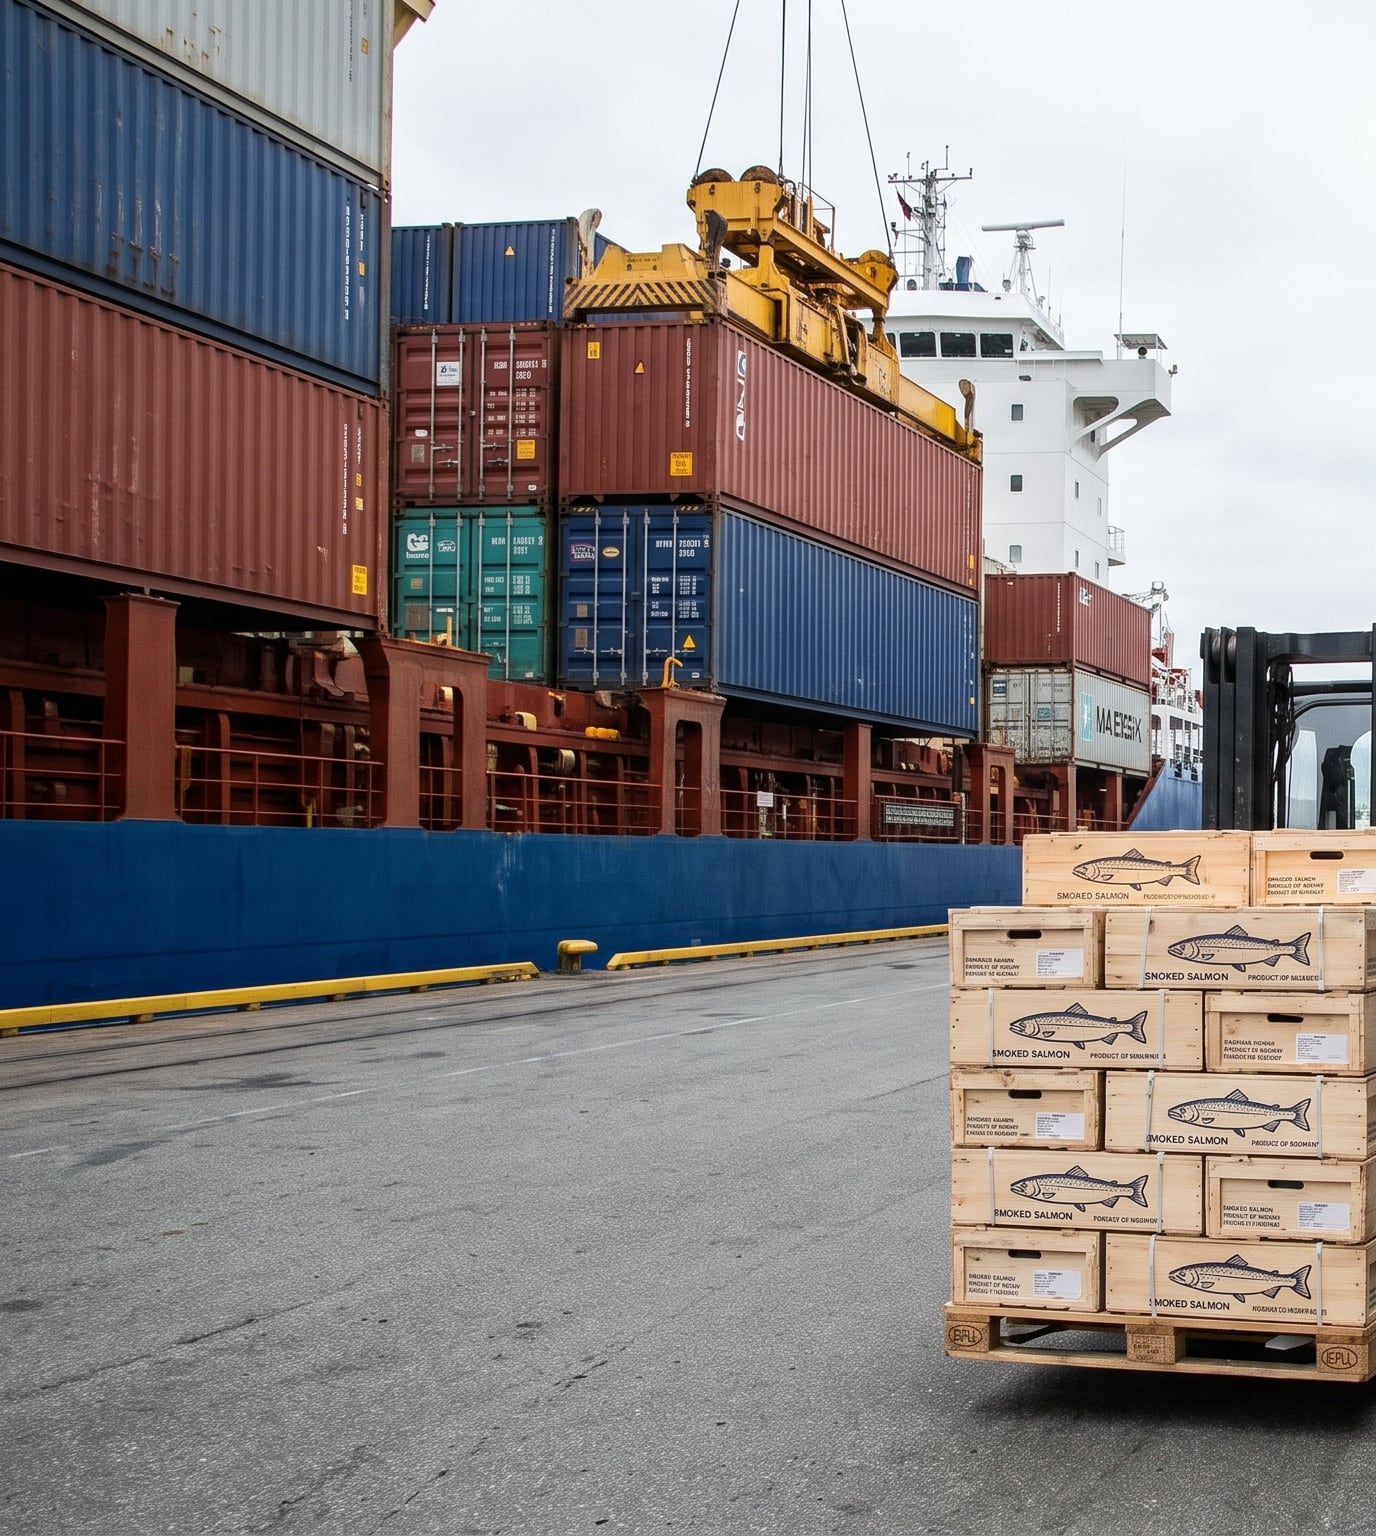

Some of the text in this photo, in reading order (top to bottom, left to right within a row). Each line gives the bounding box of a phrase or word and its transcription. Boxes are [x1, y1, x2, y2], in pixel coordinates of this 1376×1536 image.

[1095, 892, 1129, 900] SALMON
[1187, 972, 1229, 981] SALMON
[1031, 1049, 1070, 1058] SALMON
[1187, 1135, 1228, 1145] SALMON
[1034, 1210, 1073, 1220] SALMON
[1190, 1300, 1230, 1310] SALMON
